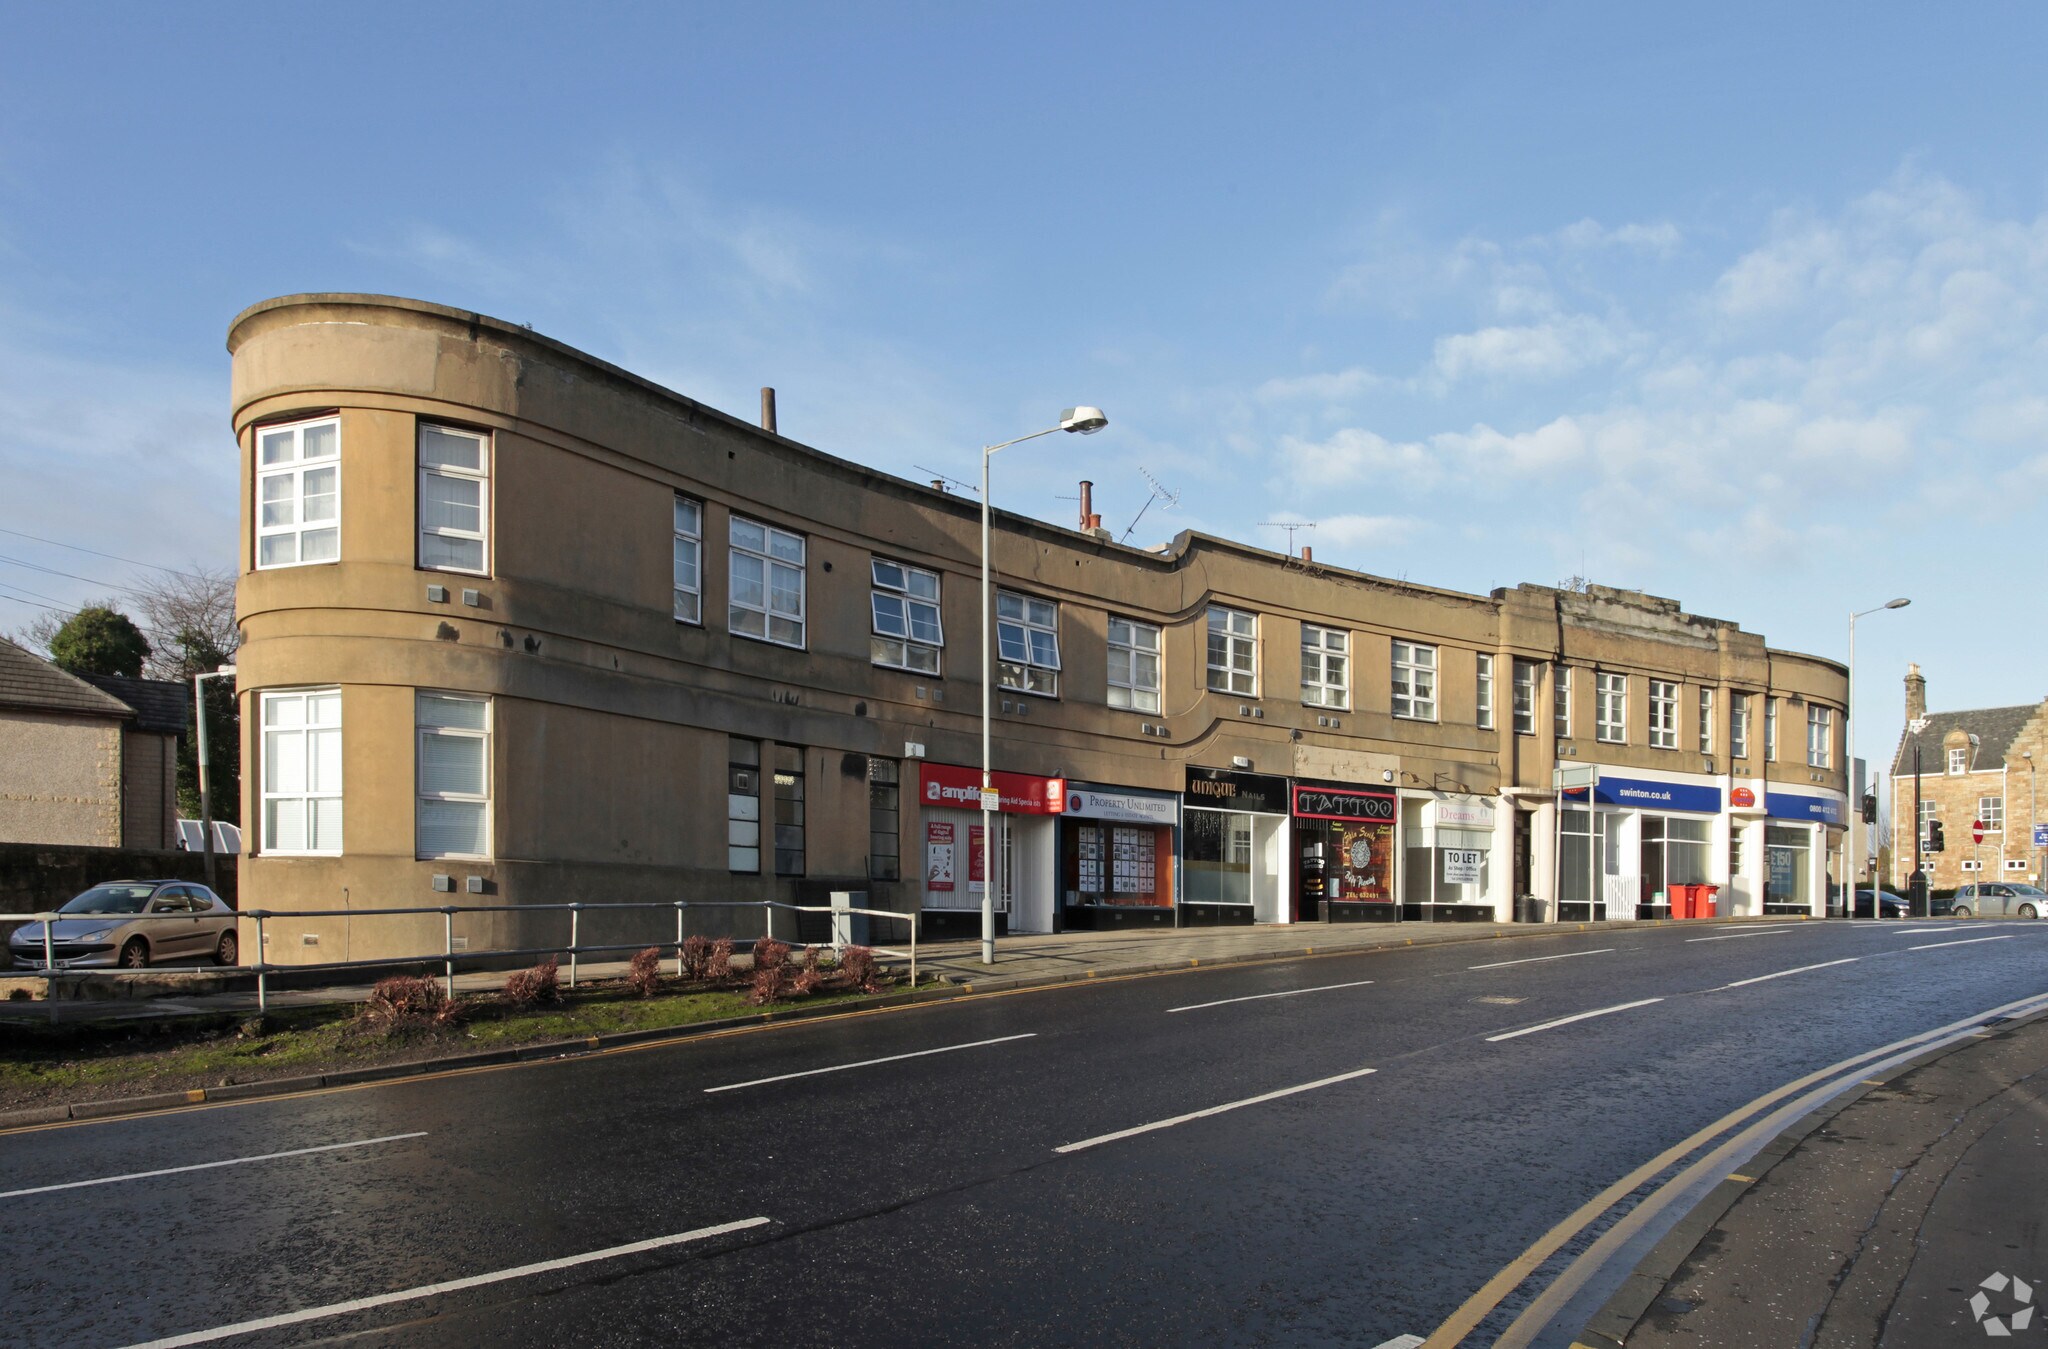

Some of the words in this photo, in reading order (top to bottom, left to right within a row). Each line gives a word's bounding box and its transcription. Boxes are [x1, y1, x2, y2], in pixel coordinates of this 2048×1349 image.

[942, 785, 981, 802] amplifo
[1620, 788, 1671, 800] swinton.co.uk
[1090, 795, 1126, 809] PROPERTY
[1127, 798, 1166, 812] UNLIMITED
[1299, 793, 1392, 817] TATTOO
[1809, 804, 1821, 813] 0800
[1441, 807, 1475, 820] Dreams
[1448, 852, 1459, 863] TO
[1462, 853, 1477, 864] LET
[1771, 851, 1791, 866] £150
